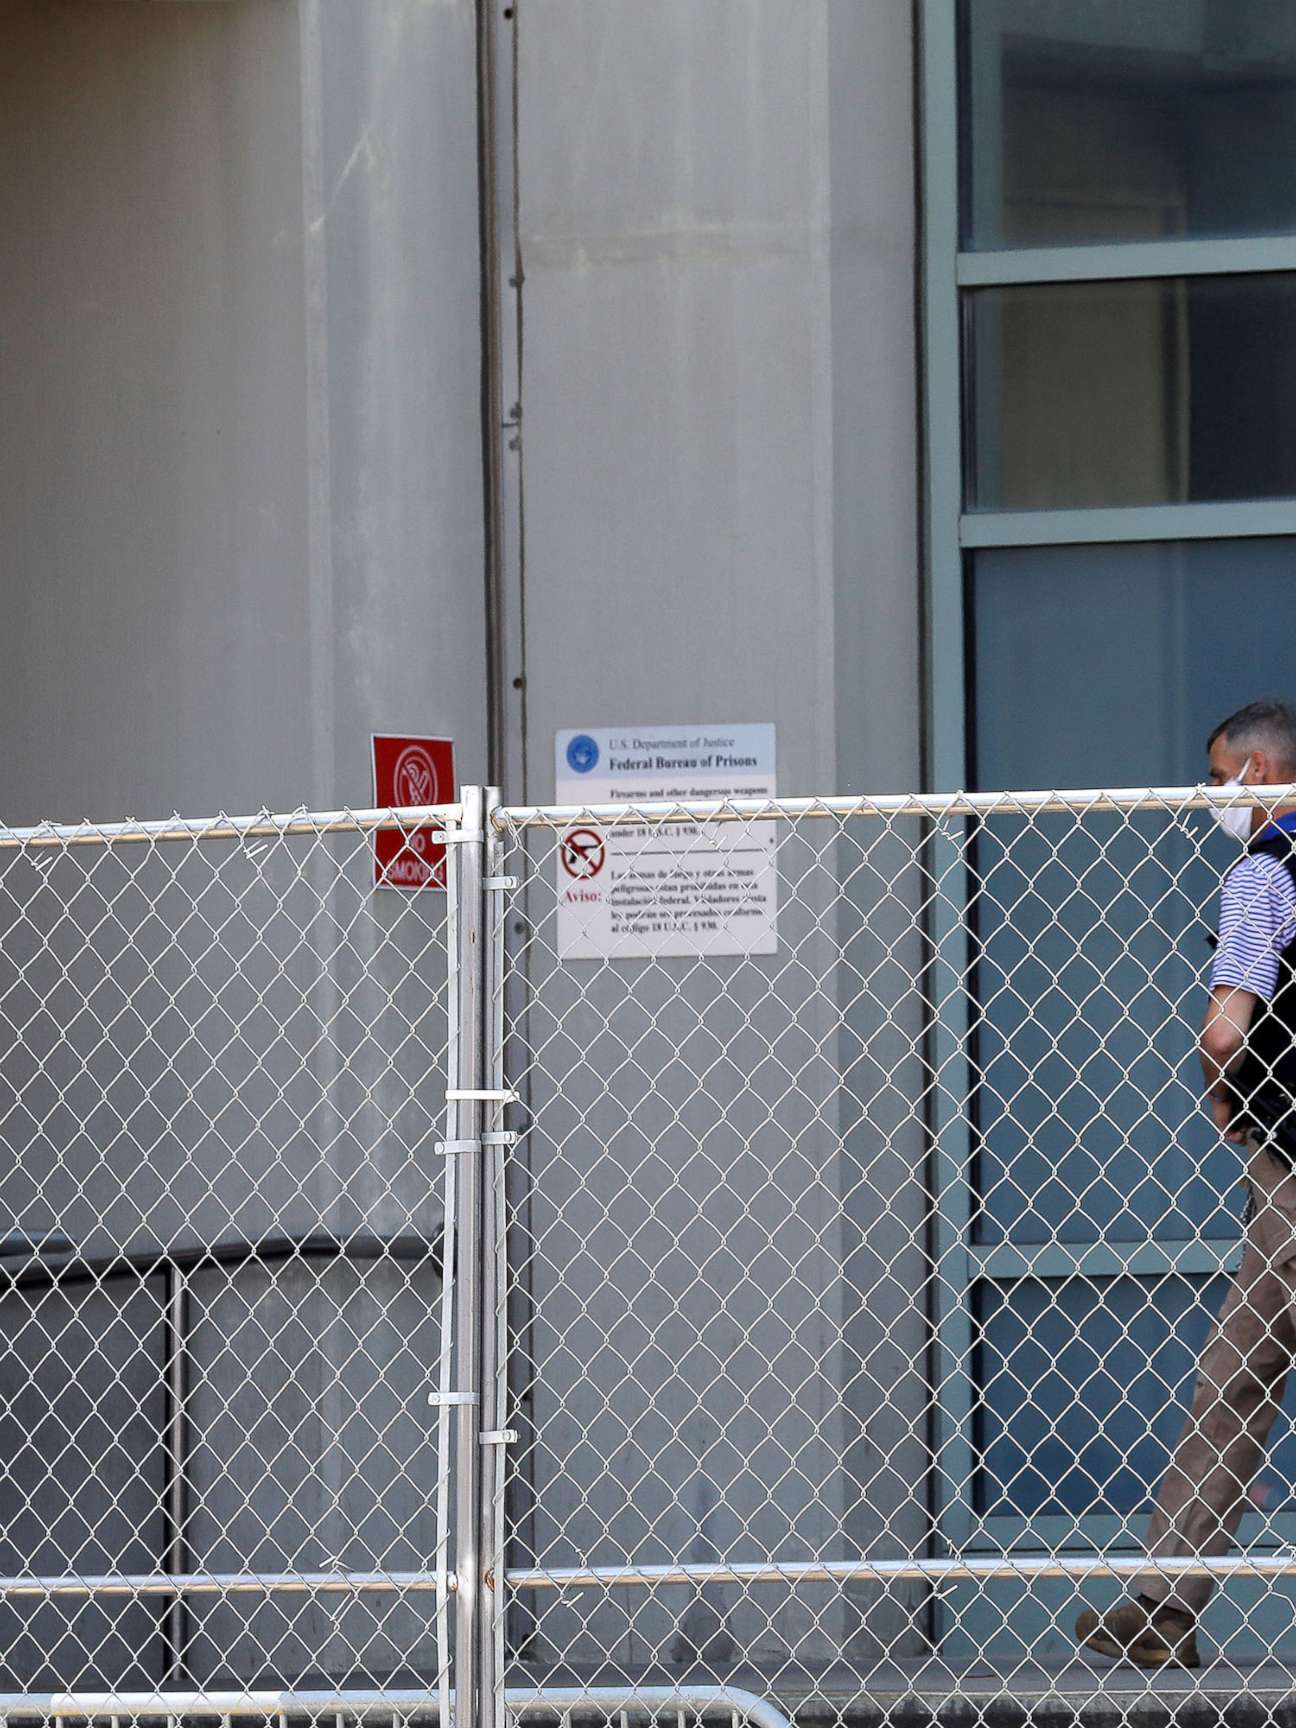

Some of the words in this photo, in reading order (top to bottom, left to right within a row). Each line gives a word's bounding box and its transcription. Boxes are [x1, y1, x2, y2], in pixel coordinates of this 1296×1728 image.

[609, 738, 628, 750] U.S.
[632, 738, 688, 751] Department
[690, 737, 701, 748] of
[703, 736, 735, 748] Justice
[609, 757, 653, 771] Federal
[656, 757, 697, 769] Bureau
[700, 755, 713, 768] of
[715, 754, 758, 767] Prisons
[610, 789, 647, 799] Firearms
[649, 788, 664, 797] and
[666, 788, 687, 797] other
[733, 786, 768, 796] weapons
